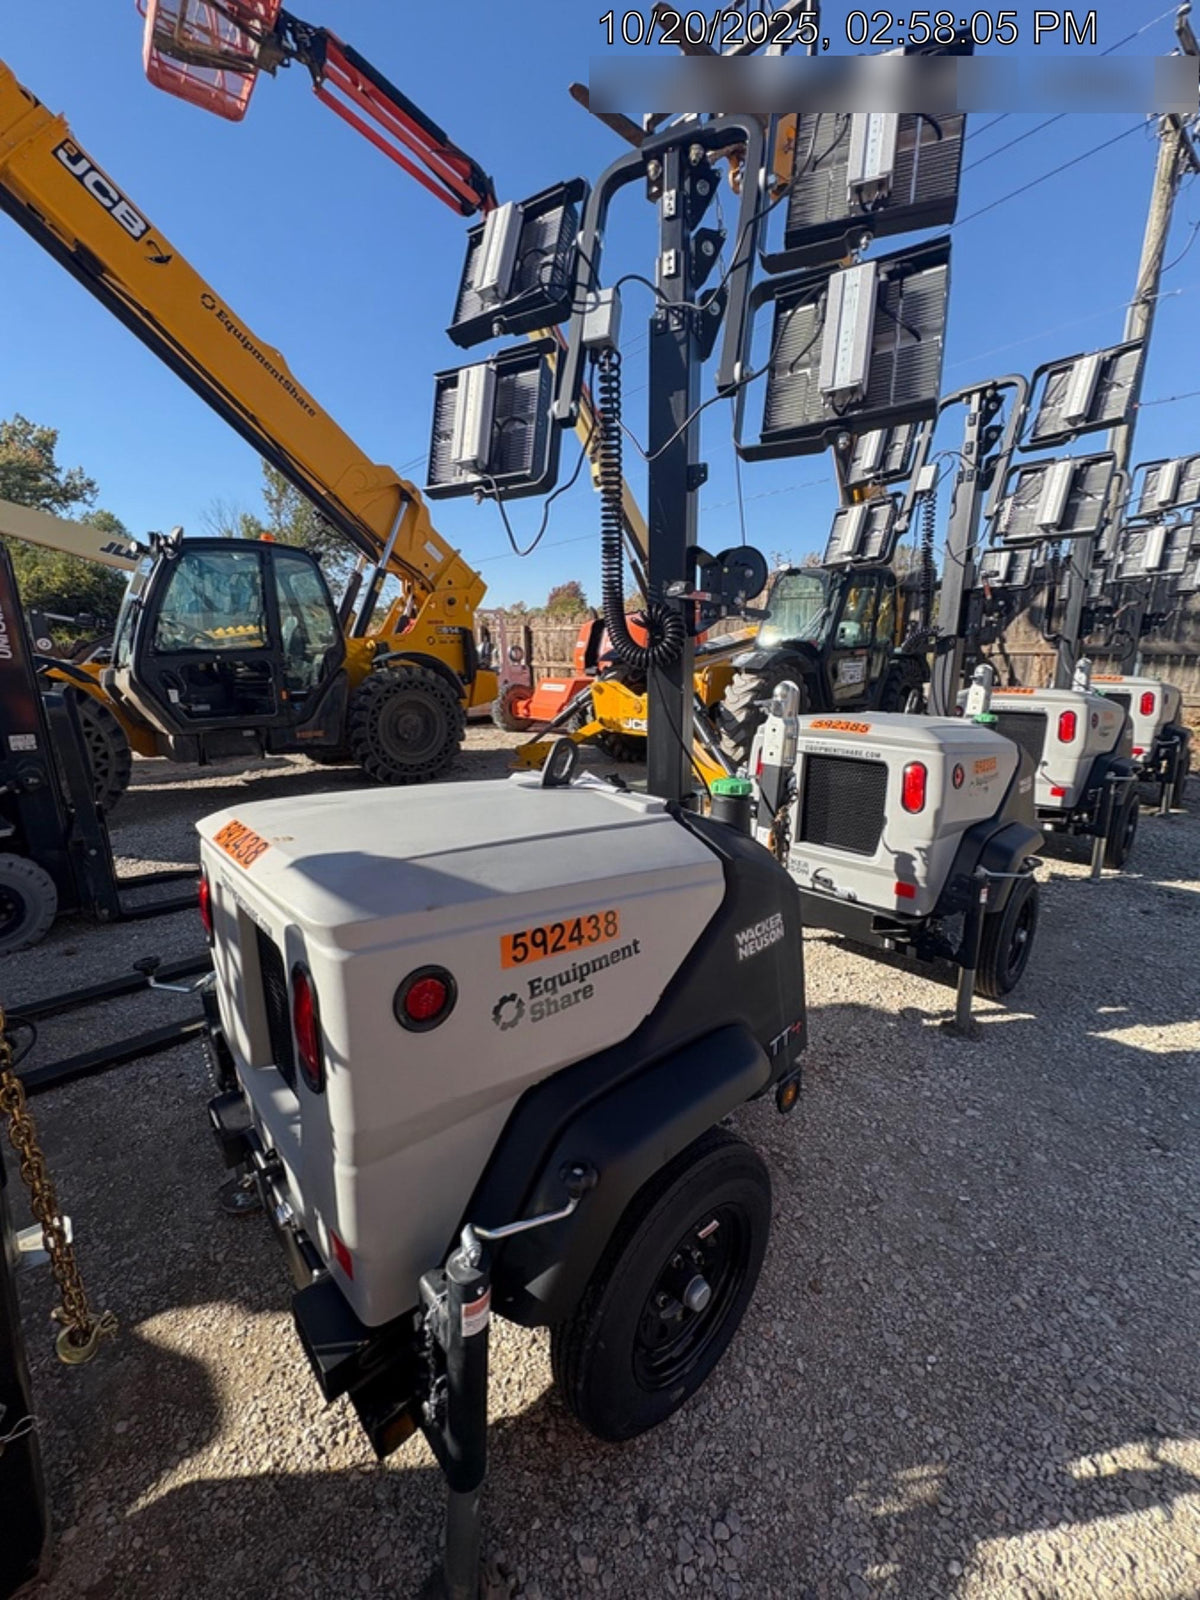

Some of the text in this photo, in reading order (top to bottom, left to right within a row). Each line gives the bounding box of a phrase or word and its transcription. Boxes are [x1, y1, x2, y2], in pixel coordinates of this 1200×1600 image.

[56, 142, 148, 238] JCB
[216, 309, 316, 417] EquipmentShare
[511, 909, 618, 964] 592438
[735, 912, 783, 945] WACKER
[738, 926, 785, 960] NEUSON
[527, 938, 641, 999] Equipment
[529, 984, 594, 1023] Share
